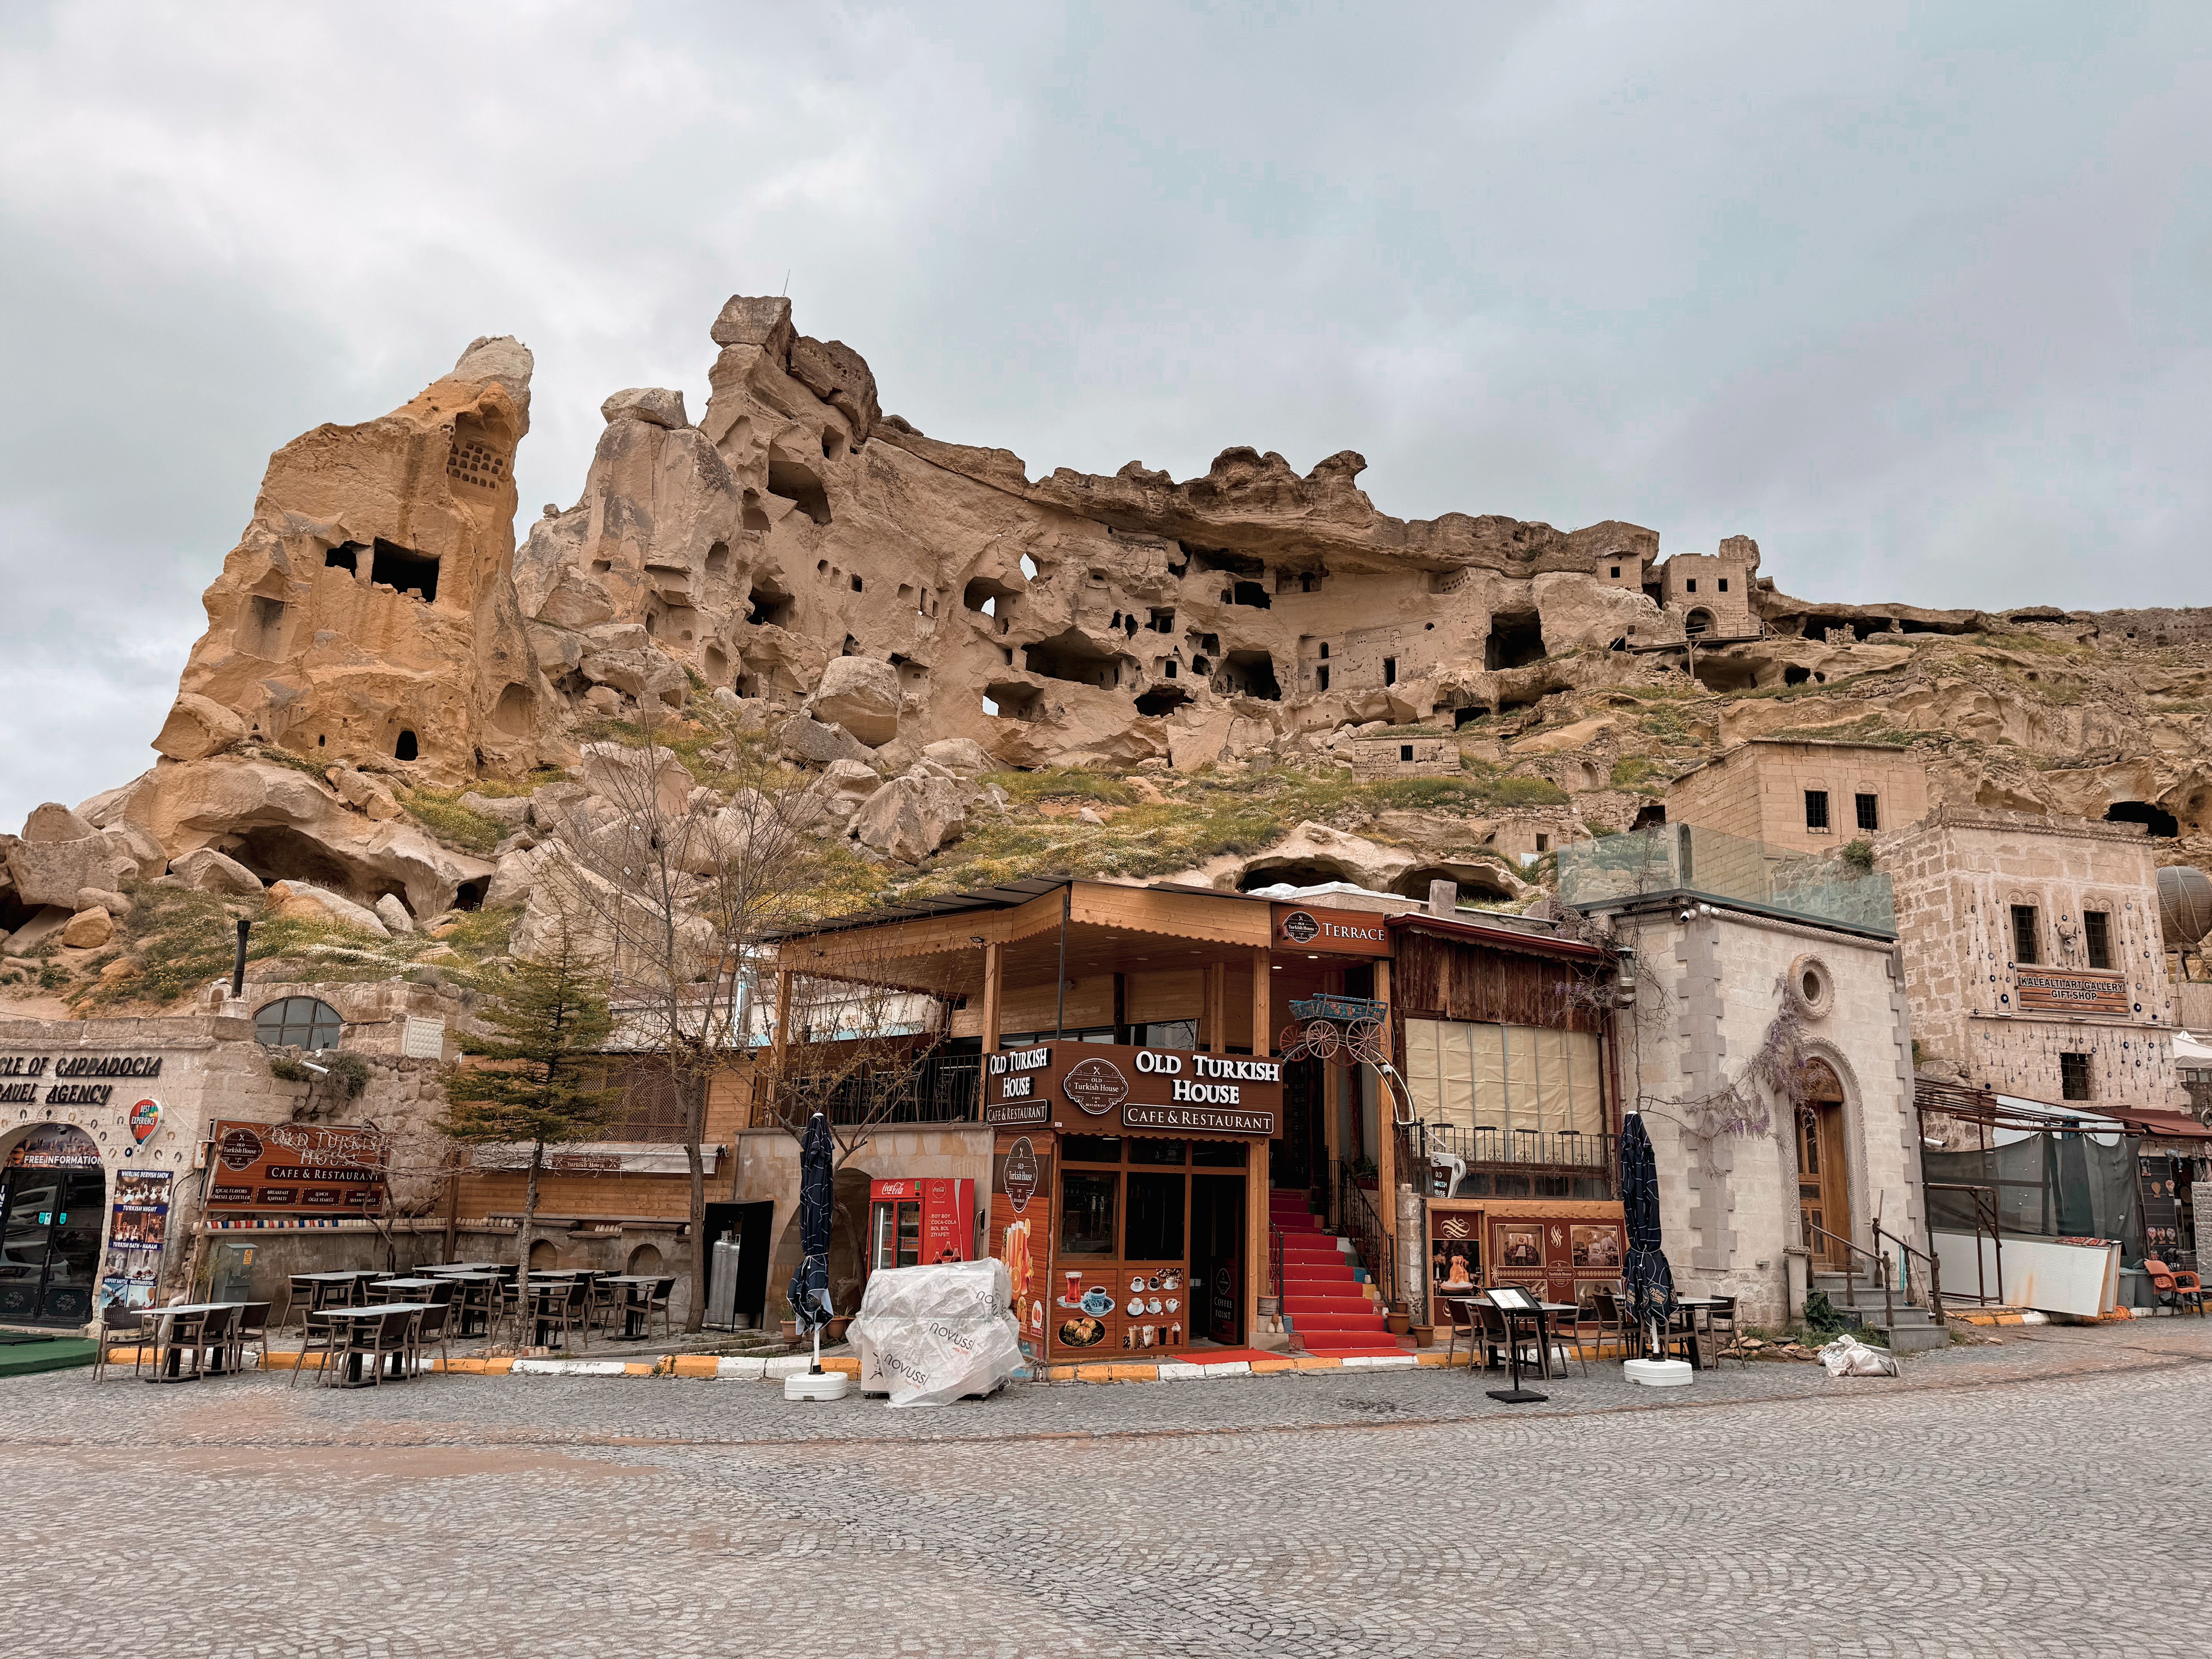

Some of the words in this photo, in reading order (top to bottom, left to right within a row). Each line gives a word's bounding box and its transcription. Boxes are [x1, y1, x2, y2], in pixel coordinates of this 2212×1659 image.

[1322, 922, 1384, 940] TERRACE
[2021, 977, 2063, 988] KALEALTI
[2065, 980, 2082, 989] ART
[2084, 981, 2124, 992] GALLERY
[2051, 990, 2071, 999] GIFT
[2073, 992, 2097, 1000] SHOP
[28, 1057, 49, 1076] OF
[55, 1056, 162, 1077] CAPPADOCIA
[990, 1055, 1007, 1075] OLD
[1009, 1047, 1047, 1072] TURKISH
[1136, 1051, 1182, 1074] OLD
[1192, 1054, 1280, 1082] TURKISH
[0, 1083, 38, 1102] AVEL
[45, 1084, 113, 1105] AGENCY
[1003, 1077, 1030, 1098] HOUSE
[1074, 1082, 1099, 1091] Turkish
[1173, 1079, 1240, 1104] HOUSE
[140, 1105, 151, 1113] BEST
[988, 1109, 1001, 1122] CAFE
[1007, 1106, 1045, 1120] RESTAURANT
[131, 1116, 156, 1126] EXPERIENCE
[1128, 1108, 1165, 1123] CAFE
[1167, 1111, 1179, 1124] &
[1182, 1111, 1271, 1129] RESTAURANT
[24, 1155, 44, 1164] FREE
[272, 1167, 299, 1178] CAFE
[303, 1169, 310, 1178] &
[1214, 1297, 1232, 1308] COFFEE
[1216, 1309, 1231, 1320] POINT
[929, 1322, 975, 1350] novussi
[884, 1354, 930, 1385] novussi
